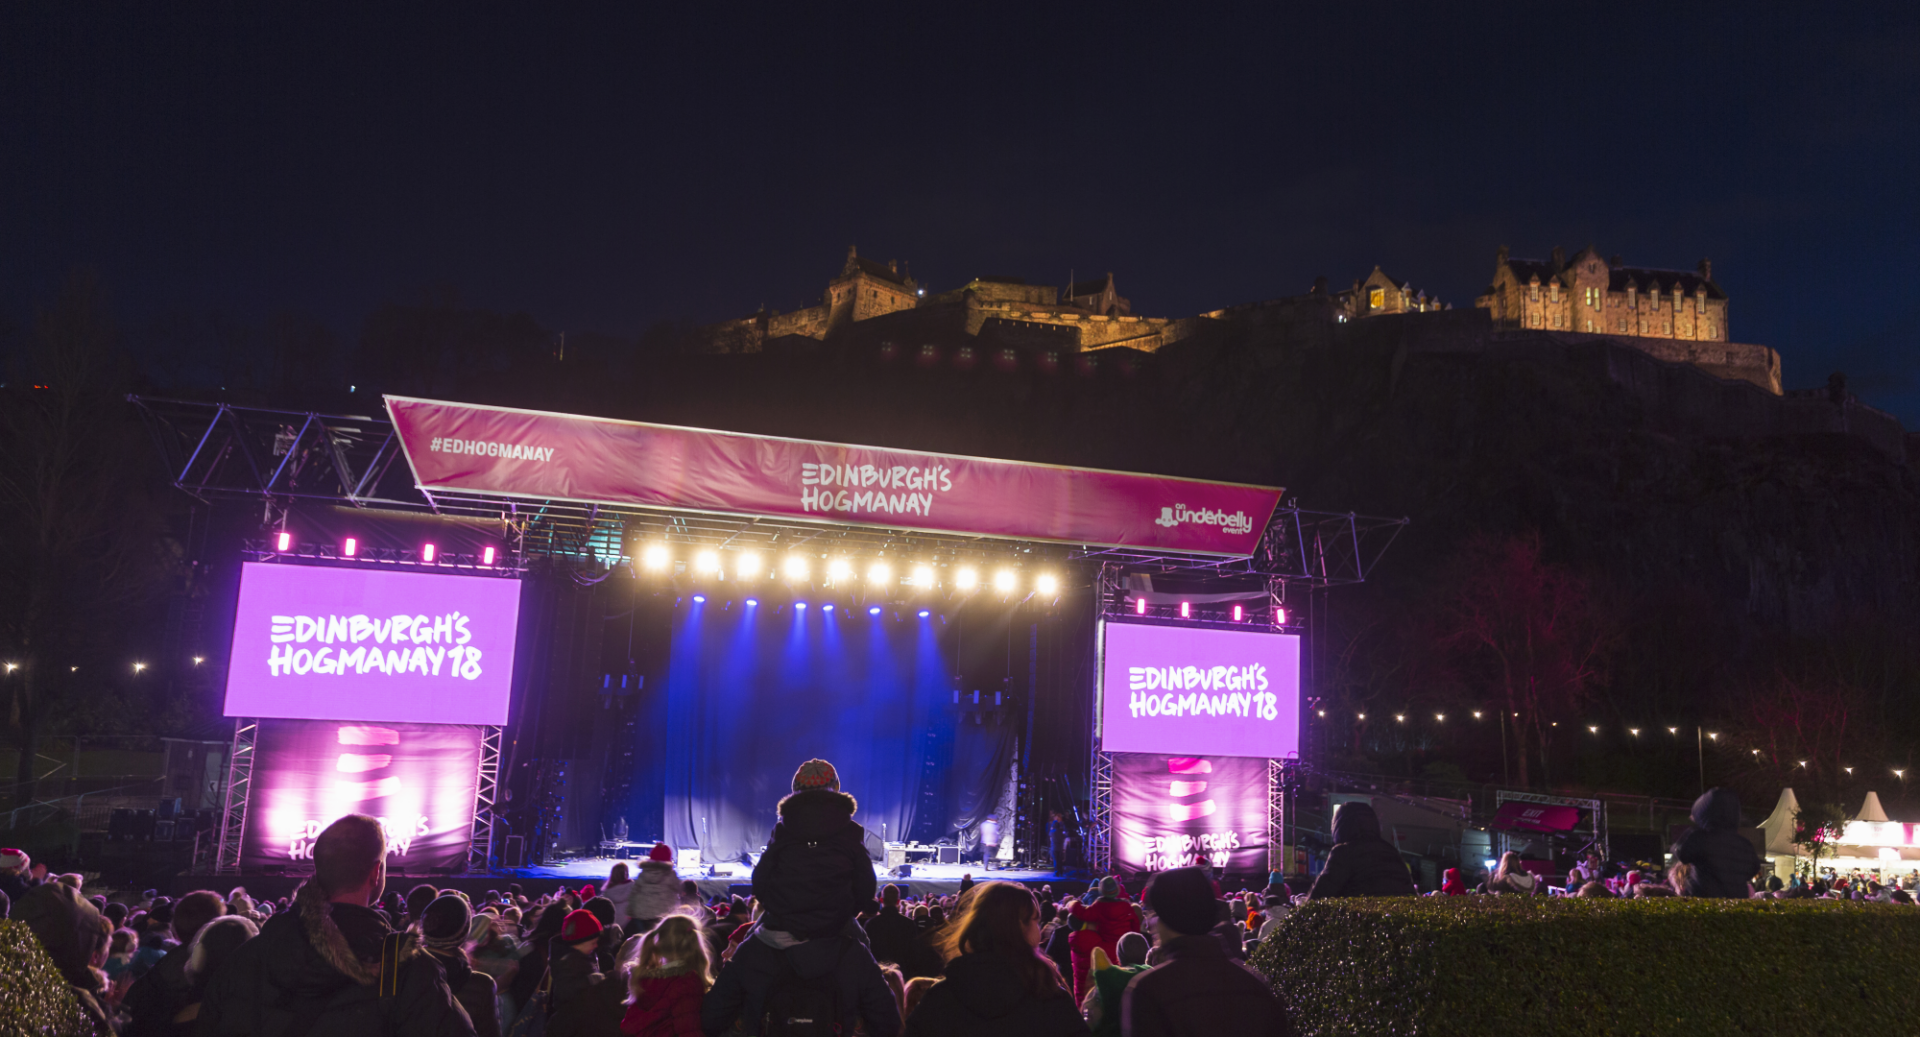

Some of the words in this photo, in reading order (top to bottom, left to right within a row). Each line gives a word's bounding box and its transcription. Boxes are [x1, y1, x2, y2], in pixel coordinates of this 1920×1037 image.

[430, 437, 555, 463] #EDHOGMANAY
[801, 463, 953, 493] EDINBURGH'S
[801, 486, 934, 516] HOGMANAY
[1176, 507, 1253, 533] underbelly
[1222, 527, 1243, 535] event
[270, 611, 472, 645] EDINBURGH'S
[1129, 663, 1269, 691] EDINBURGH'S
[1521, 808, 1546, 818] EXIT
[1143, 830, 1240, 853] EDINBURGH'S
